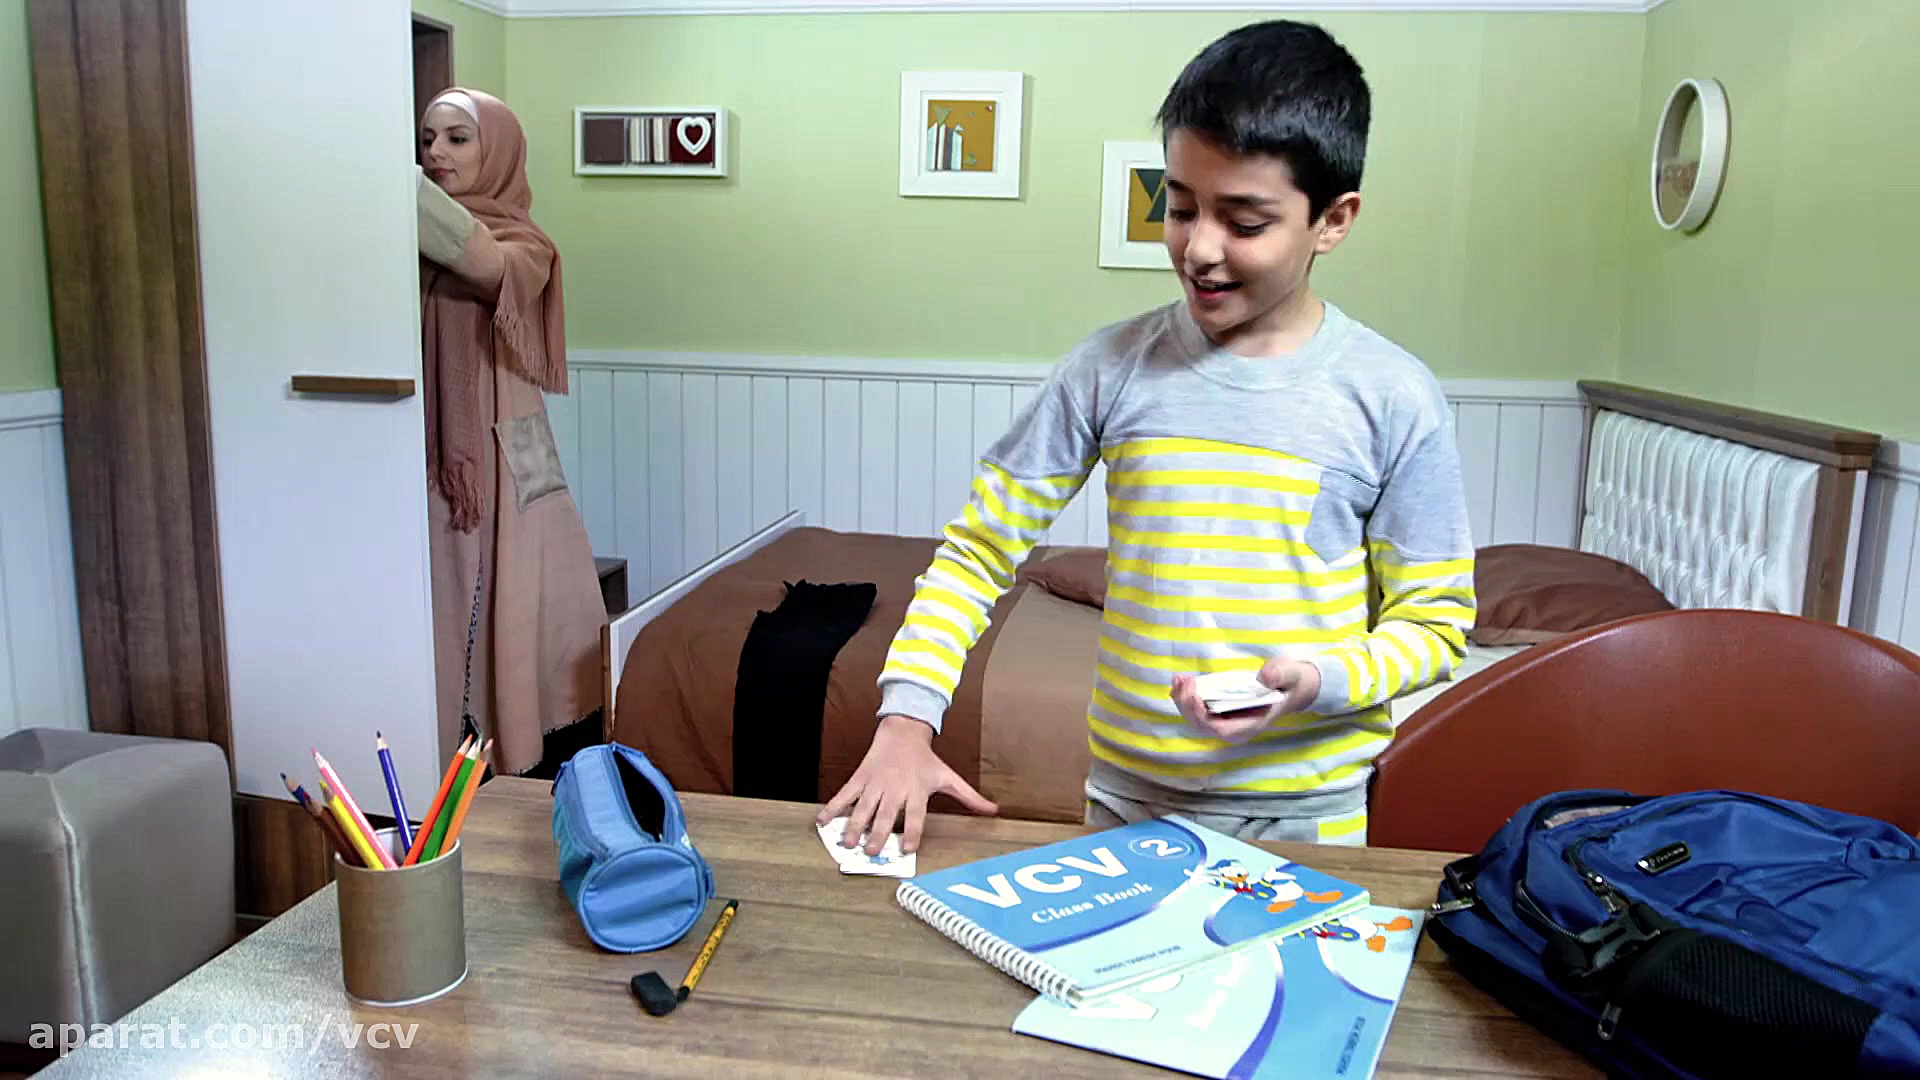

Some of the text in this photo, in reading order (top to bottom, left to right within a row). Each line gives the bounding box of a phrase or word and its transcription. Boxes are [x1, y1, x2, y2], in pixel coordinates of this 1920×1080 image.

[947, 839, 1184, 908] VCV 2
[1032, 882, 1152, 923] Class Book
